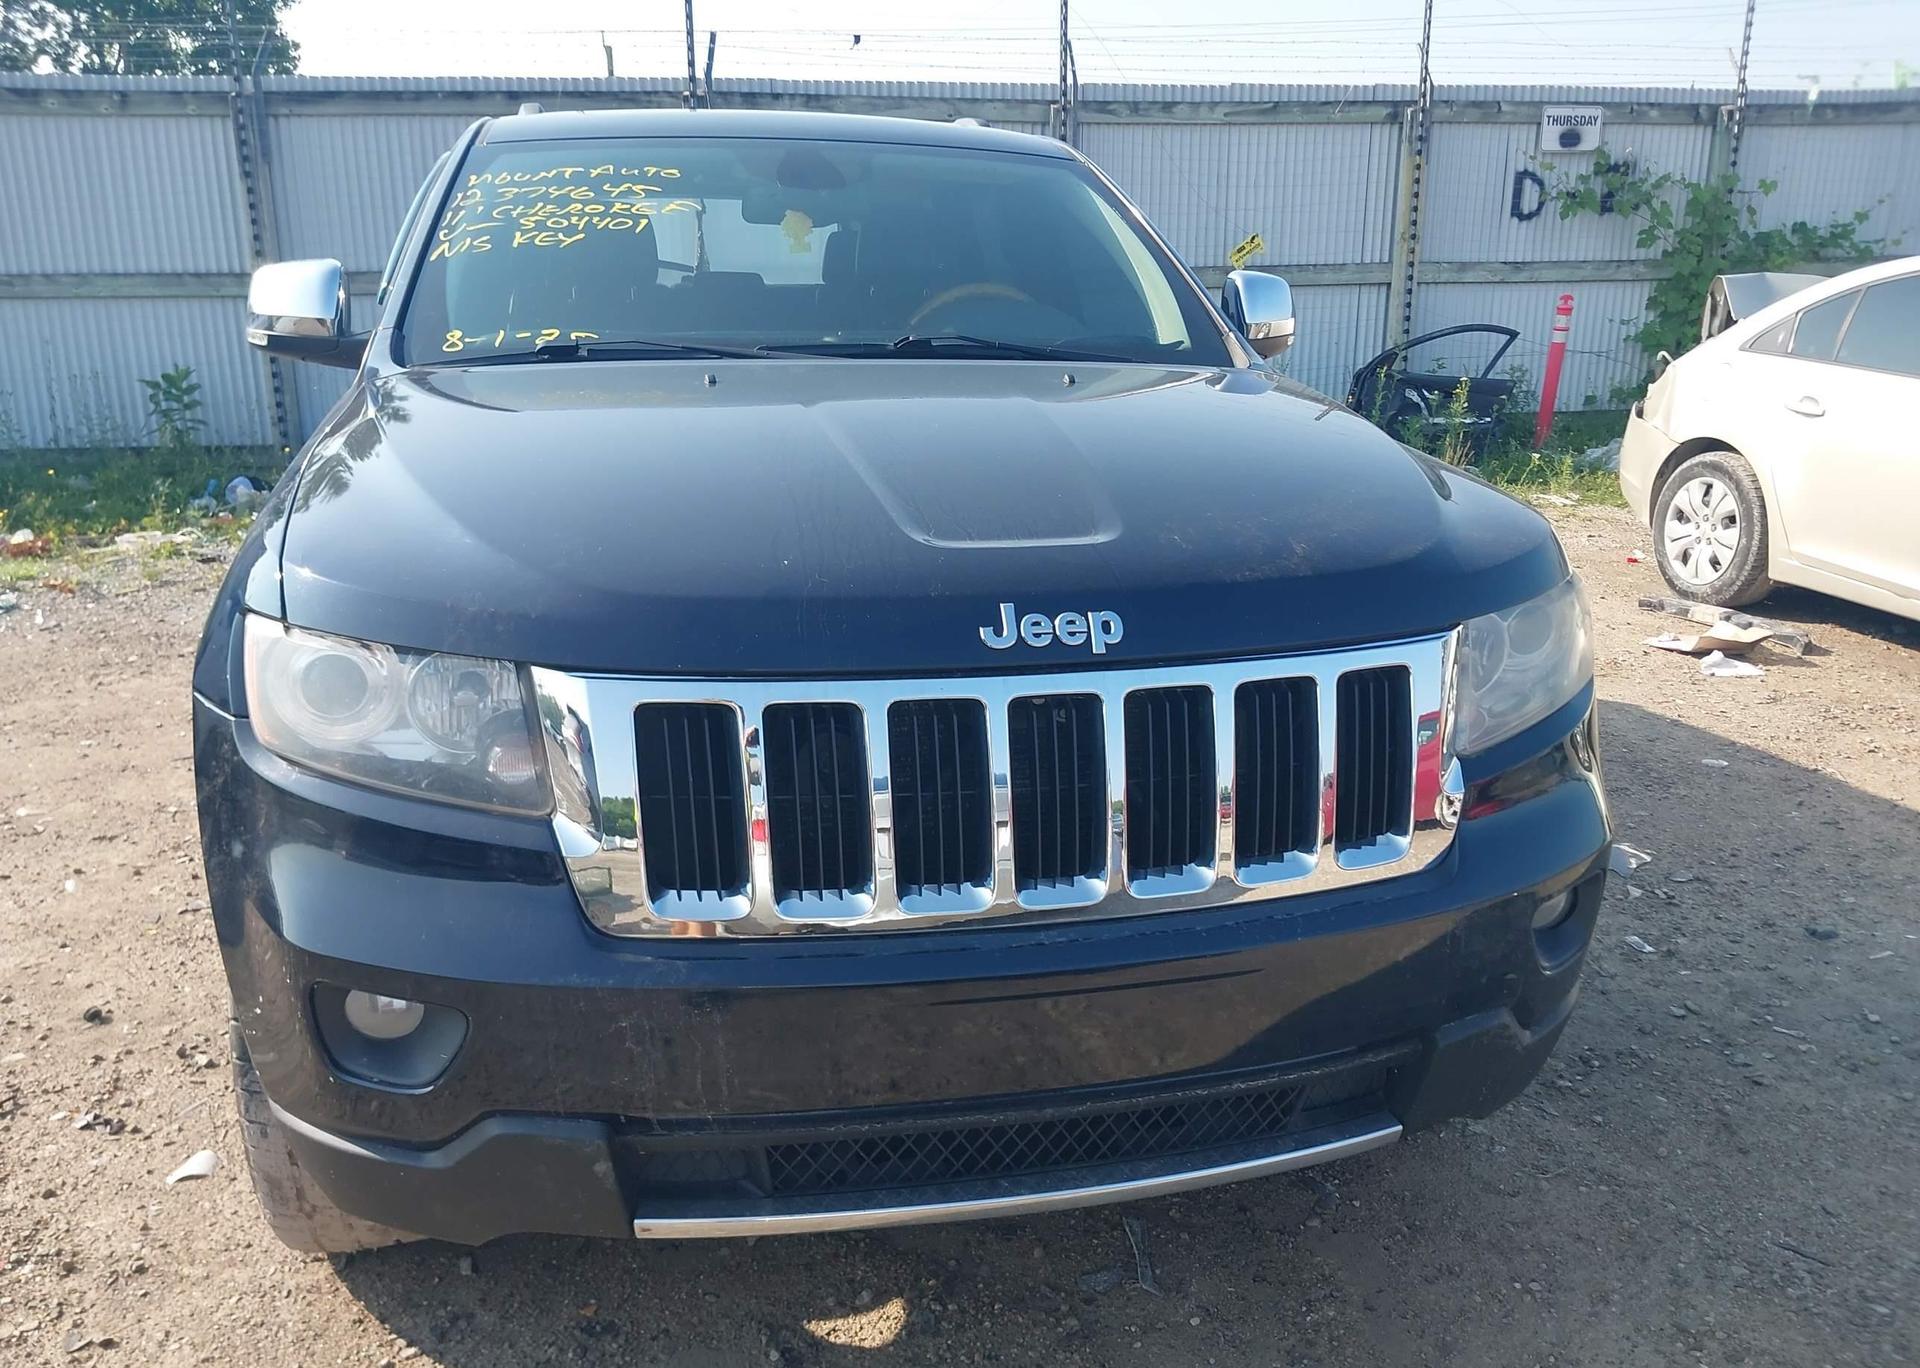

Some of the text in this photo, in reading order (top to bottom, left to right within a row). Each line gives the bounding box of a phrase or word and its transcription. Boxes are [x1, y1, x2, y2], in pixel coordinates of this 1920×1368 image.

[1546, 114, 1599, 127] THURSDAY
[512, 231, 585, 248] KEY
[979, 602, 1124, 654] Jeep
